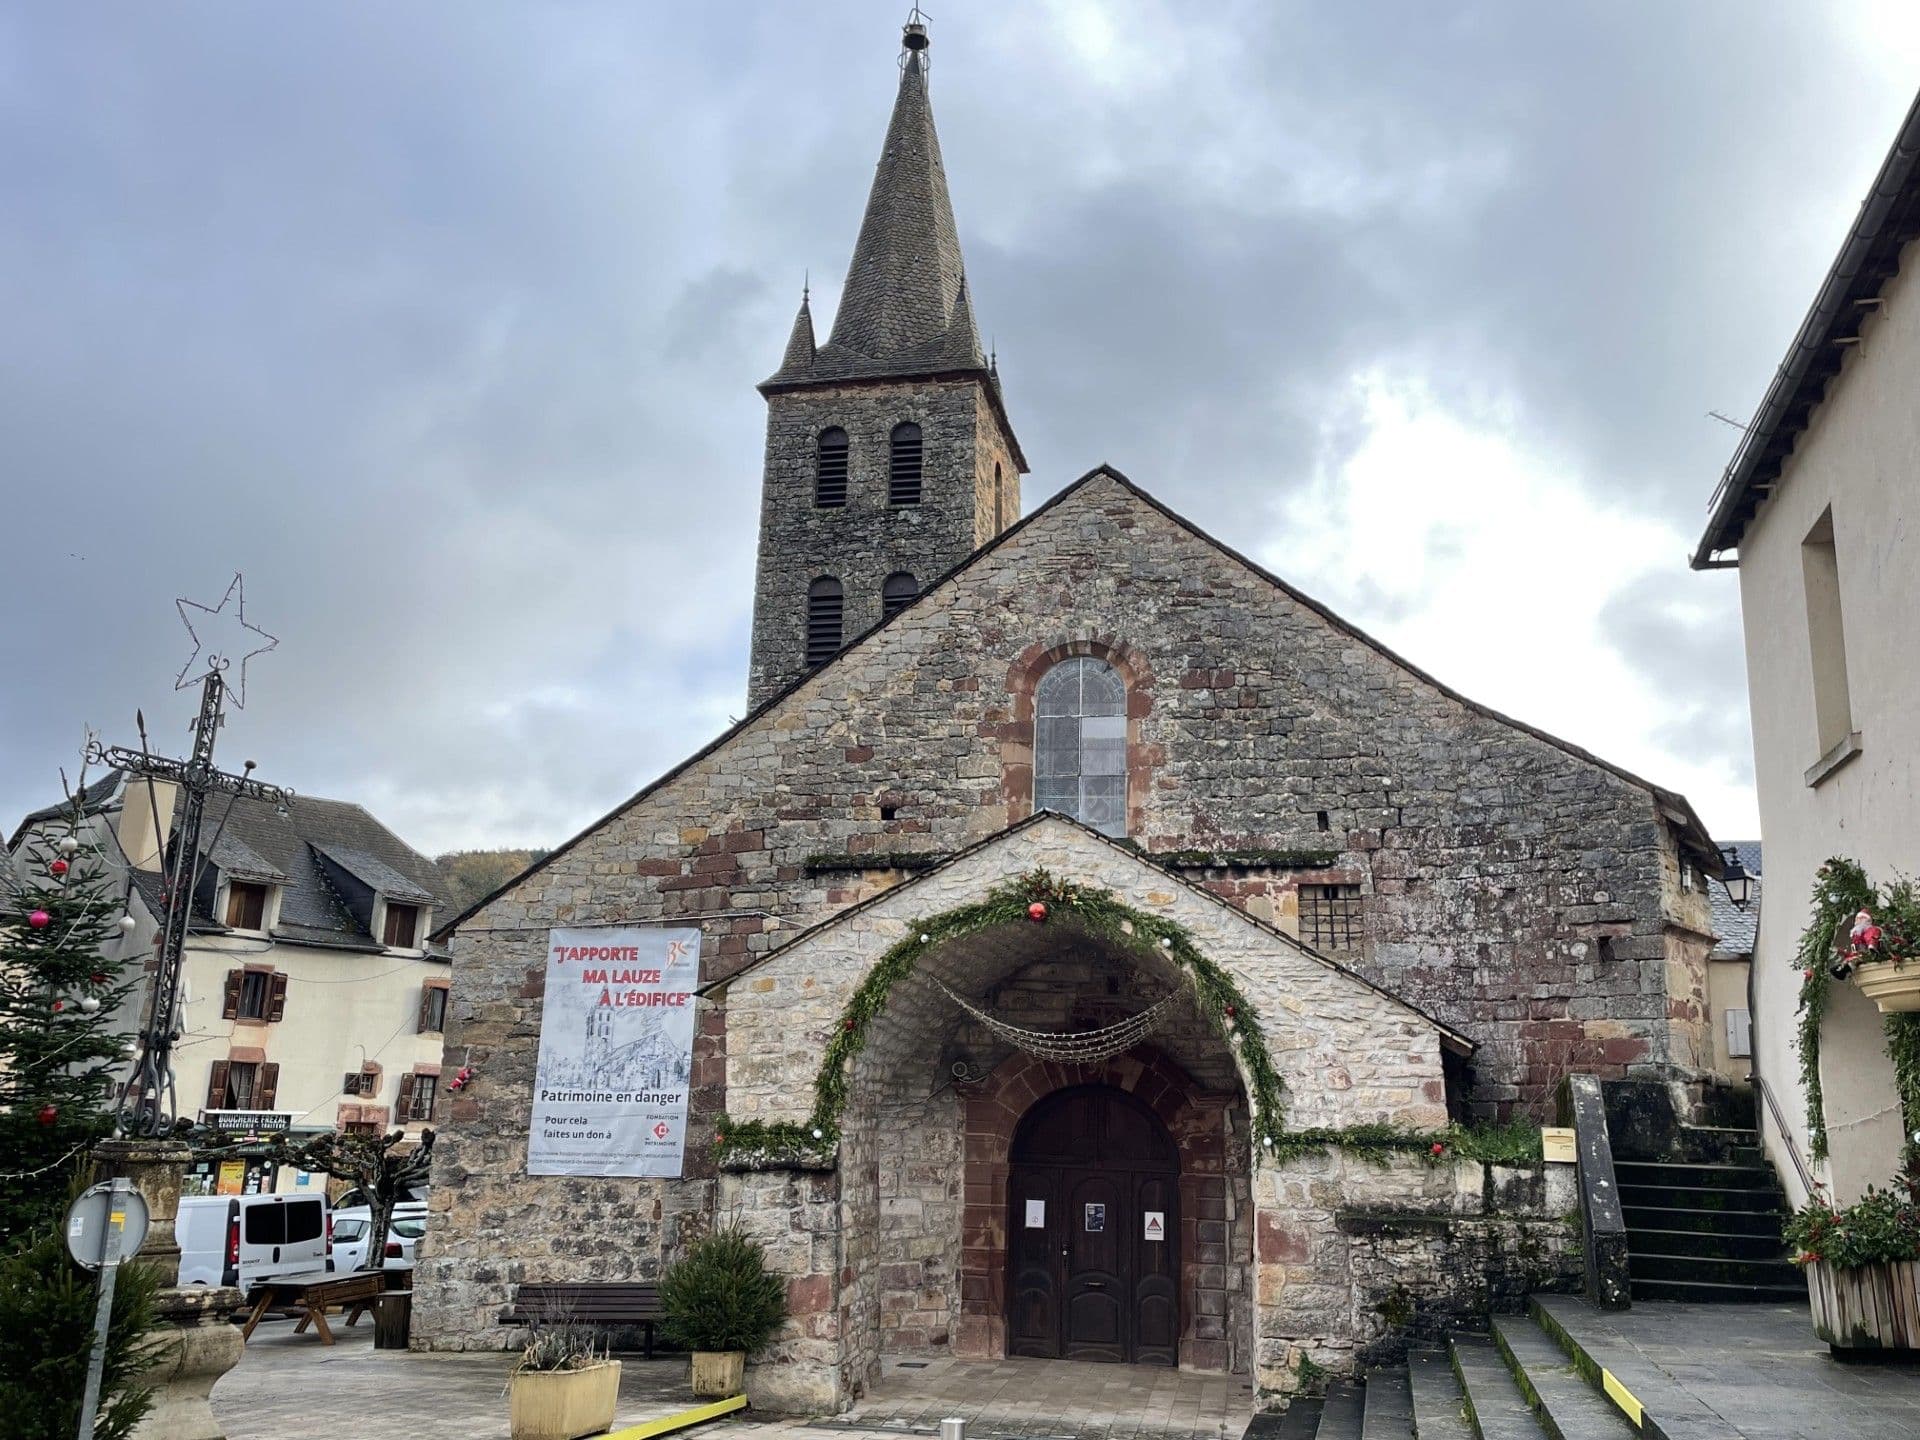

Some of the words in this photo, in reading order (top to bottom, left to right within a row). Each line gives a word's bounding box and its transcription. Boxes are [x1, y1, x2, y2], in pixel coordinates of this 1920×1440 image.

[582, 969, 608, 984] MA
[611, 969, 661, 984] LAUZE
[541, 1090, 613, 1103] Patrimoine
[616, 1092, 632, 1102] en
[635, 1091, 681, 1106] danger
[218, 1113, 259, 1123] BOUCHERIE
[545, 1116, 567, 1125] Pour
[569, 1116, 588, 1125] cela
[544, 1129, 570, 1139] faites
[572, 1131, 584, 1139] un
[587, 1129, 604, 1139] don
